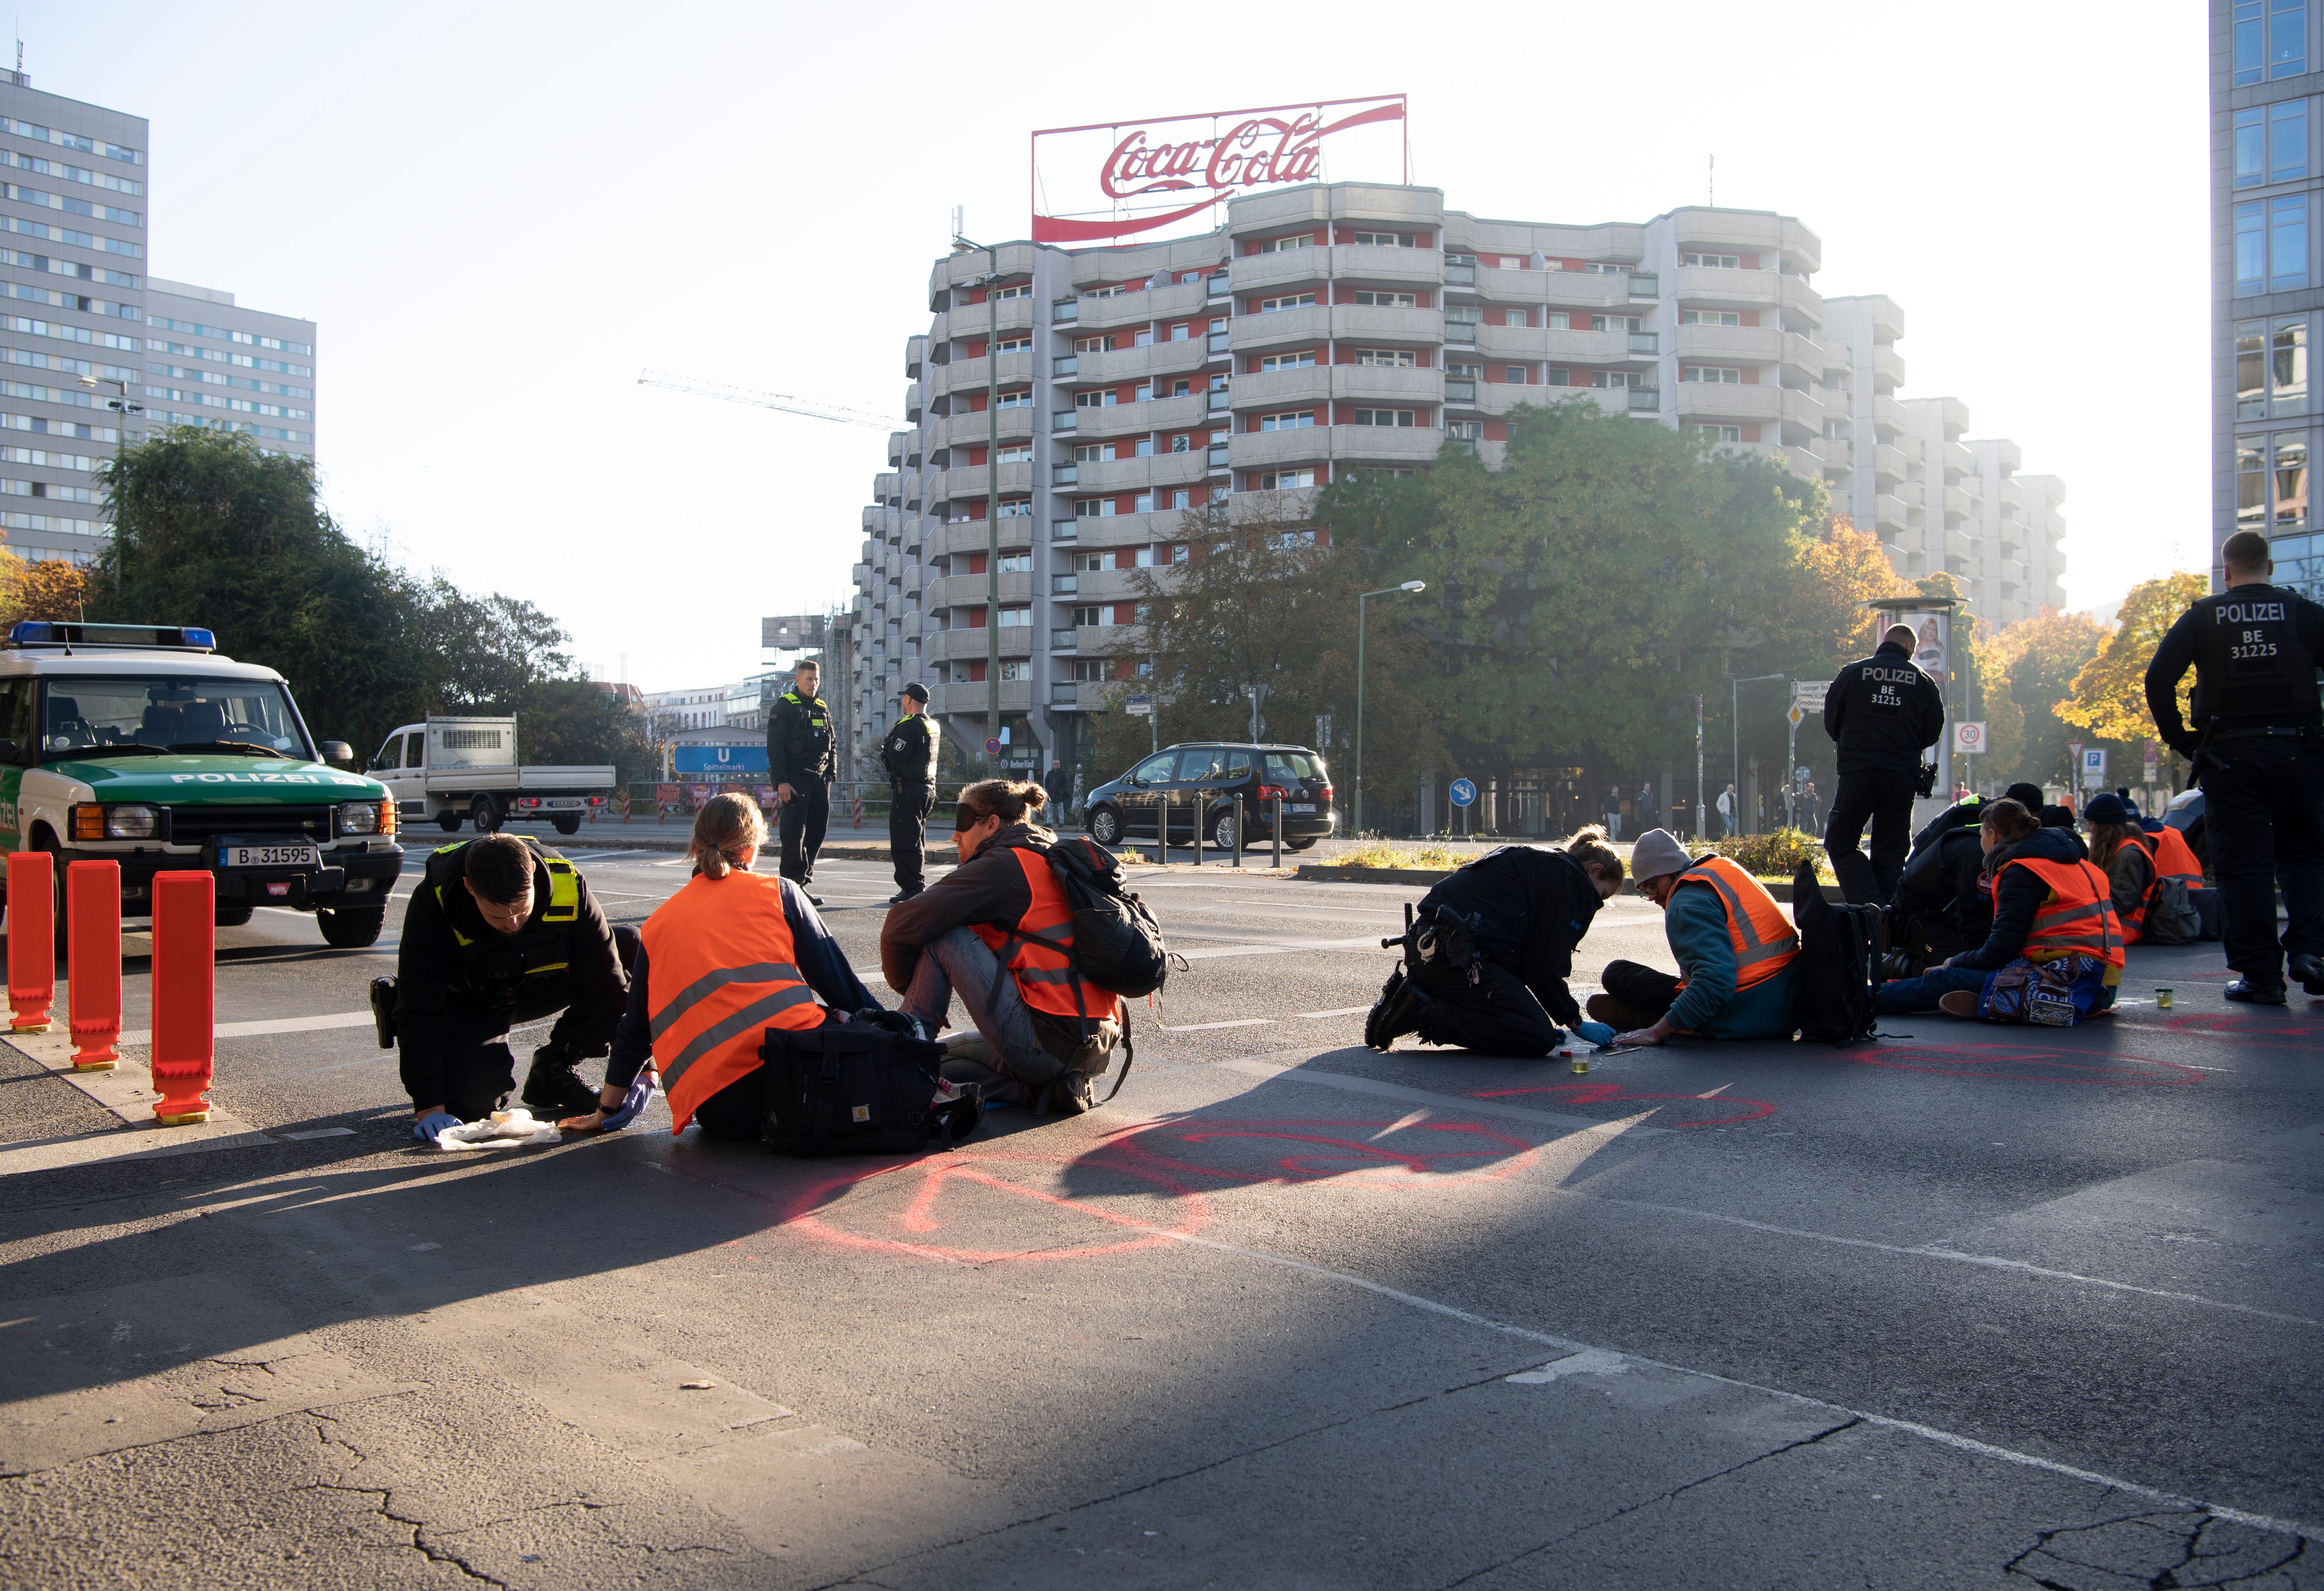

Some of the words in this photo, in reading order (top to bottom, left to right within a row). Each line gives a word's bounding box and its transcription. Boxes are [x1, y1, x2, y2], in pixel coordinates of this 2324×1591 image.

[1101, 113, 1323, 198] Coca-Cola
[2216, 603, 2285, 624] POLIZEI
[2243, 630, 2263, 643] BE
[2231, 643, 2277, 659] 31225
[1862, 667, 1916, 685] POLIZEI
[1881, 685, 1895, 695] BE
[1871, 694, 1901, 705] 31215
[1964, 730, 1976, 739] 30
[718, 748, 729, 762] U
[2090, 754, 2098, 765] P
[170, 774, 320, 783] POLIZEI
[239, 849, 249, 864] B
[261, 848, 310, 863] 31595
